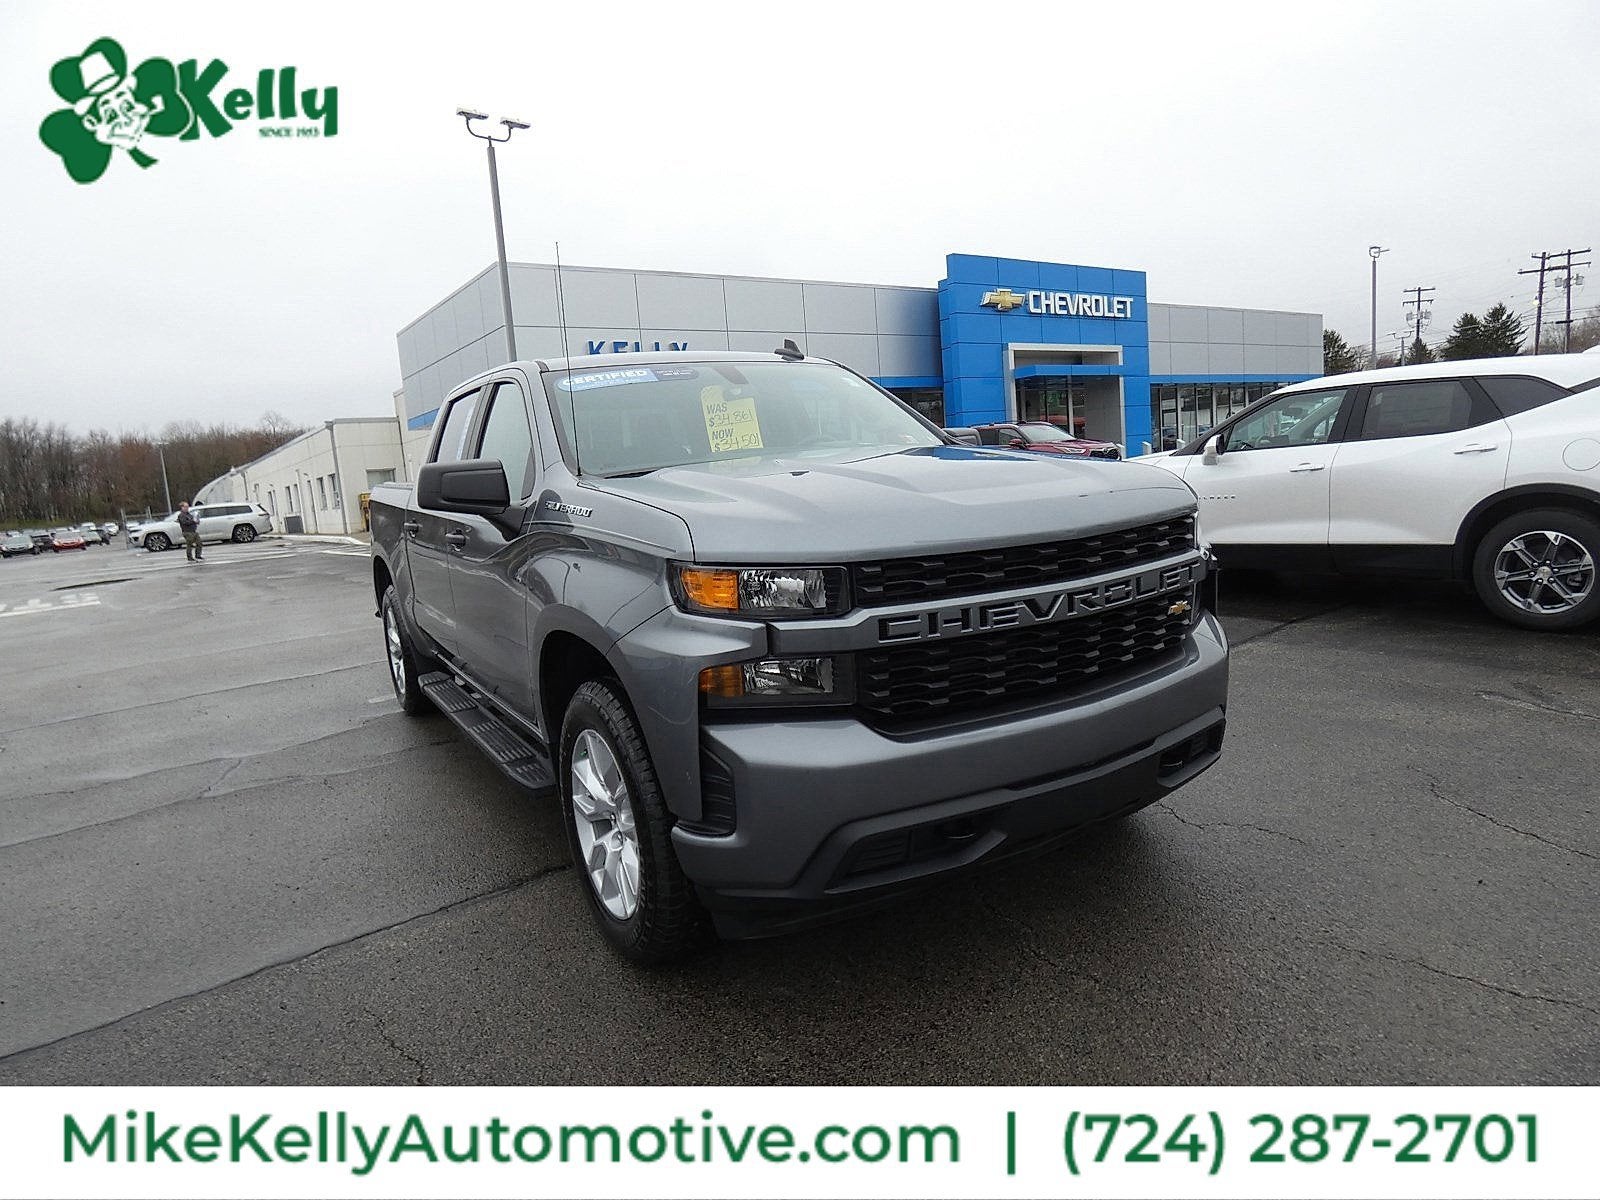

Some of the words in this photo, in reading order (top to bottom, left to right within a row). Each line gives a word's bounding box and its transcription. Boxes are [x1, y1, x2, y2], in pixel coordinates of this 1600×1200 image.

[1028, 290, 1134, 318] CHEVROLET
[562, 369, 648, 386] CERTIFIED
[706, 402, 727, 415] WAS
[711, 428, 734, 441] NOW
[878, 561, 1201, 644] CHEVROLET
